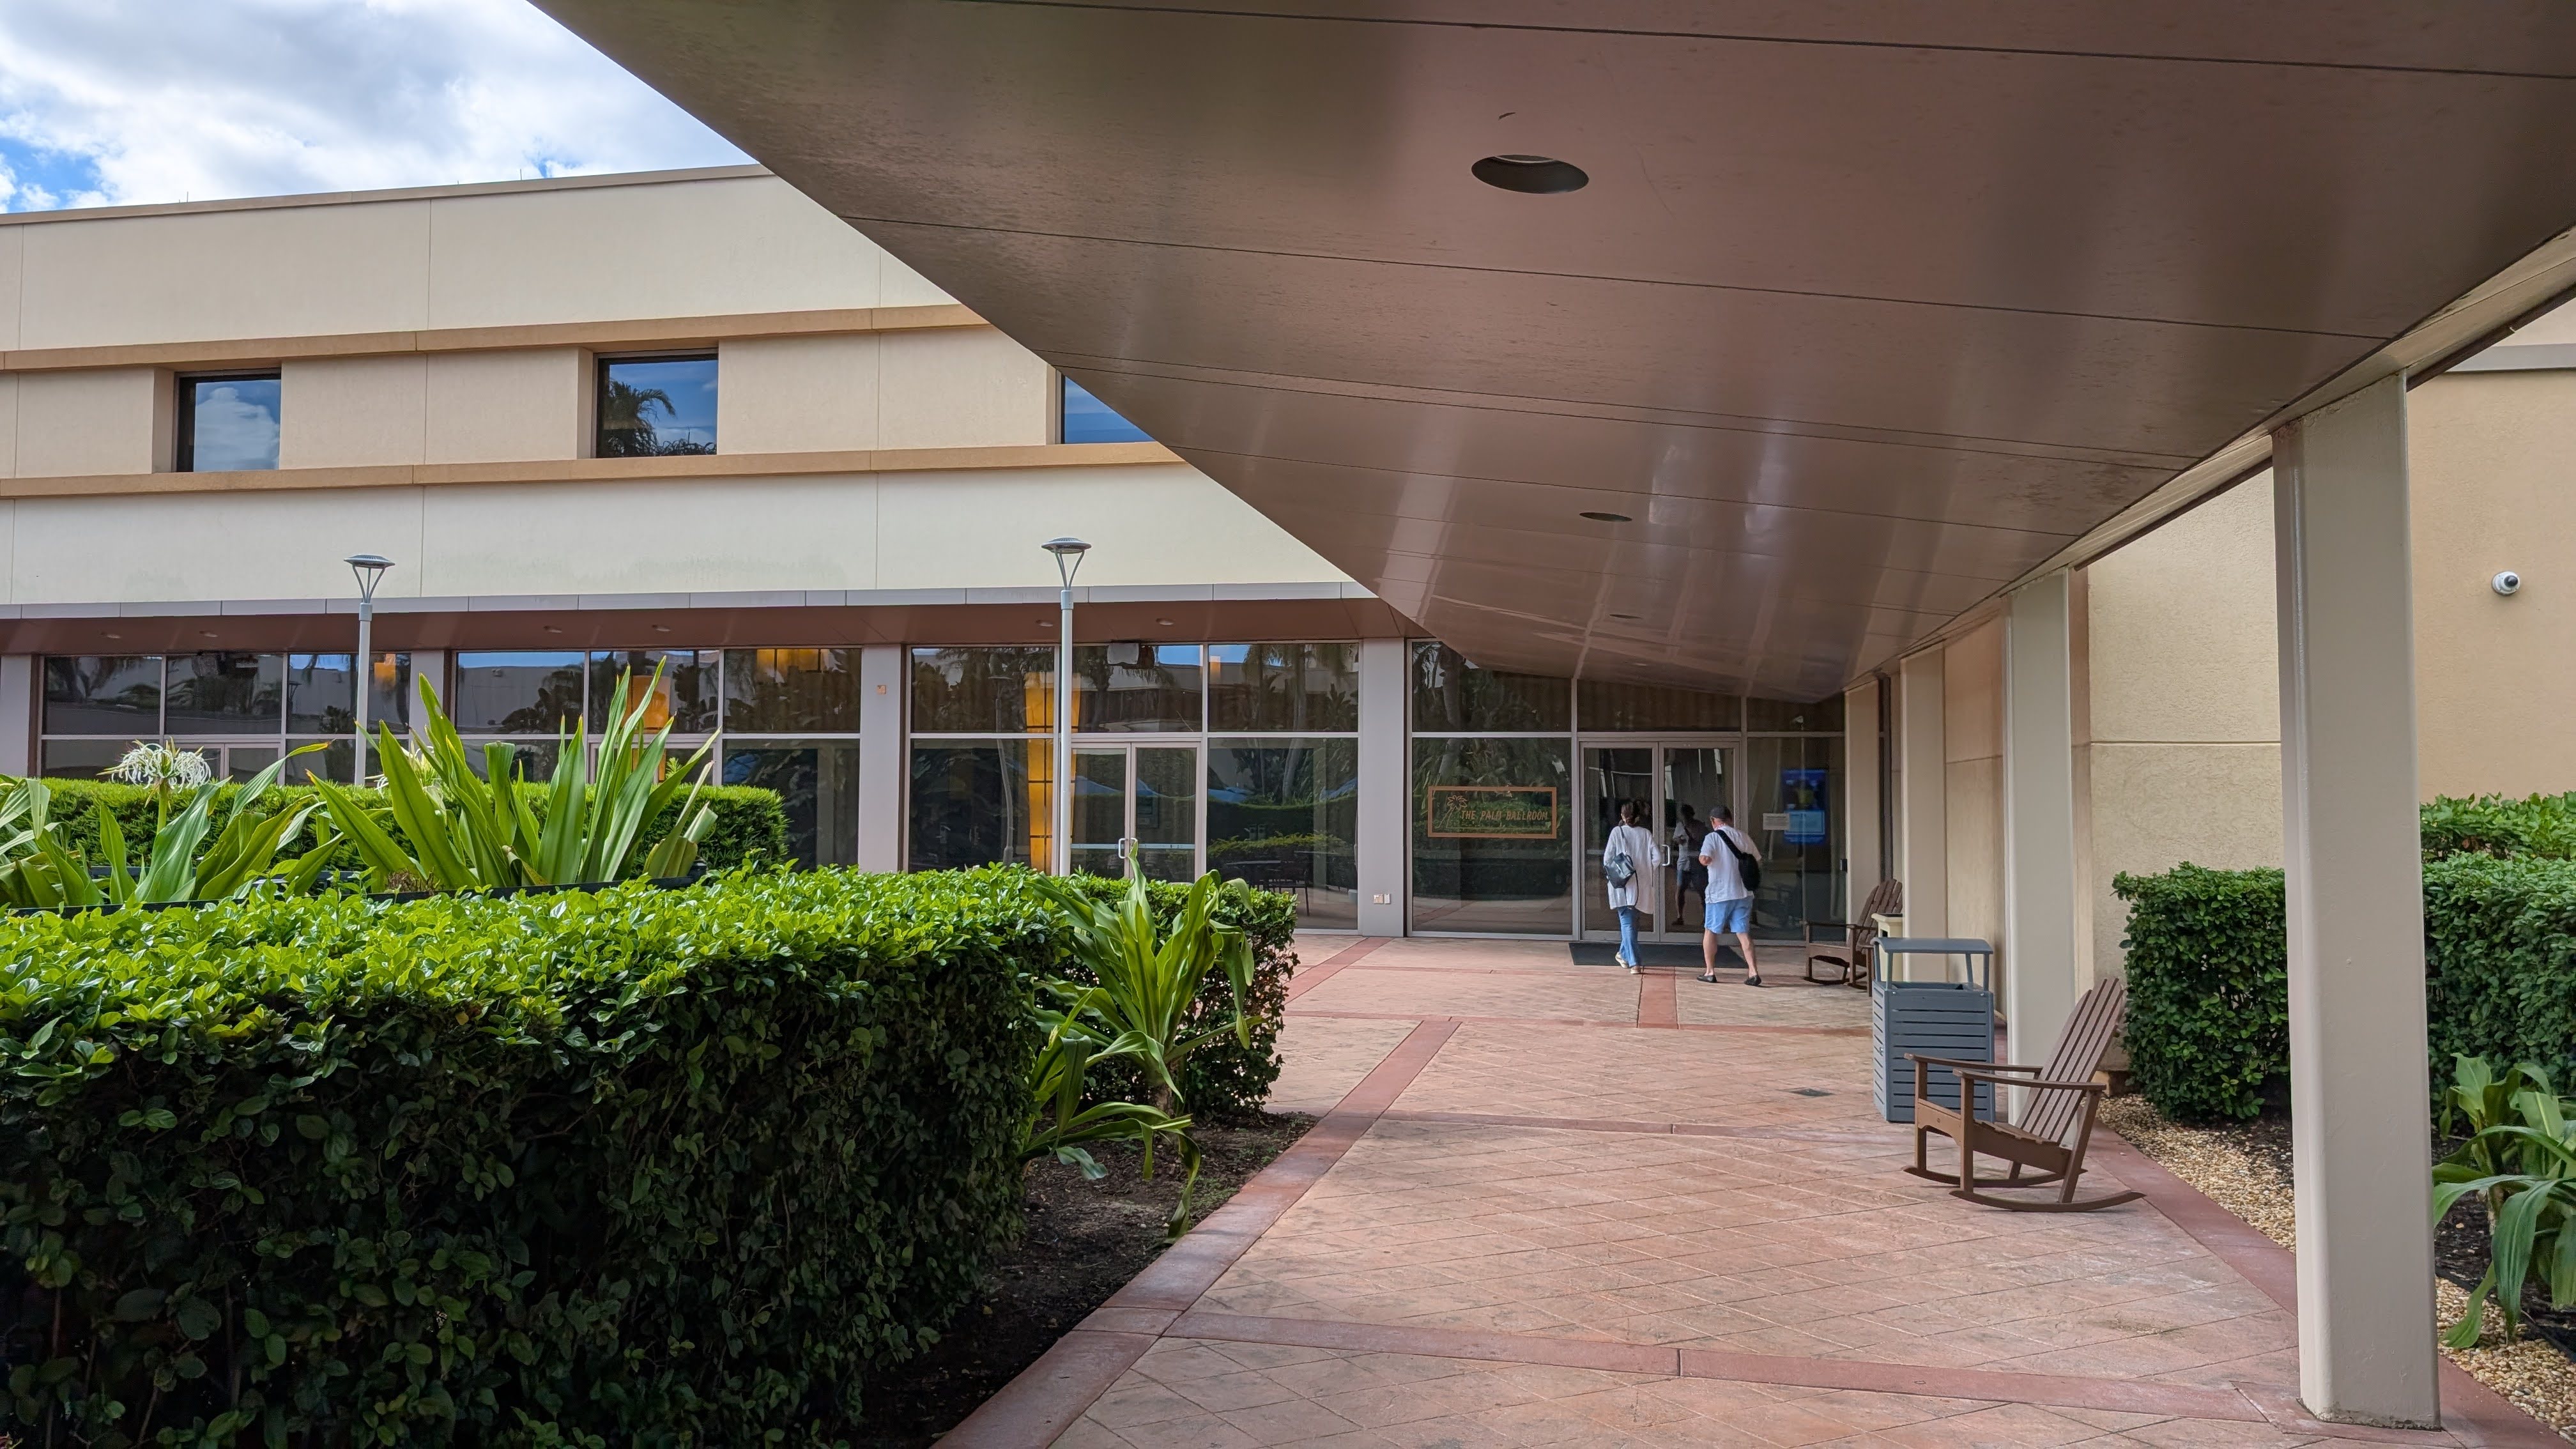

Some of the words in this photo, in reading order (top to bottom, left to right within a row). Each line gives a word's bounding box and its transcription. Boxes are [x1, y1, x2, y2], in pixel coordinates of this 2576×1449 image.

[1461, 810, 1476, 820] THE
[1480, 810, 1502, 820] PALM
[1506, 810, 1548, 821] BALLROOM
